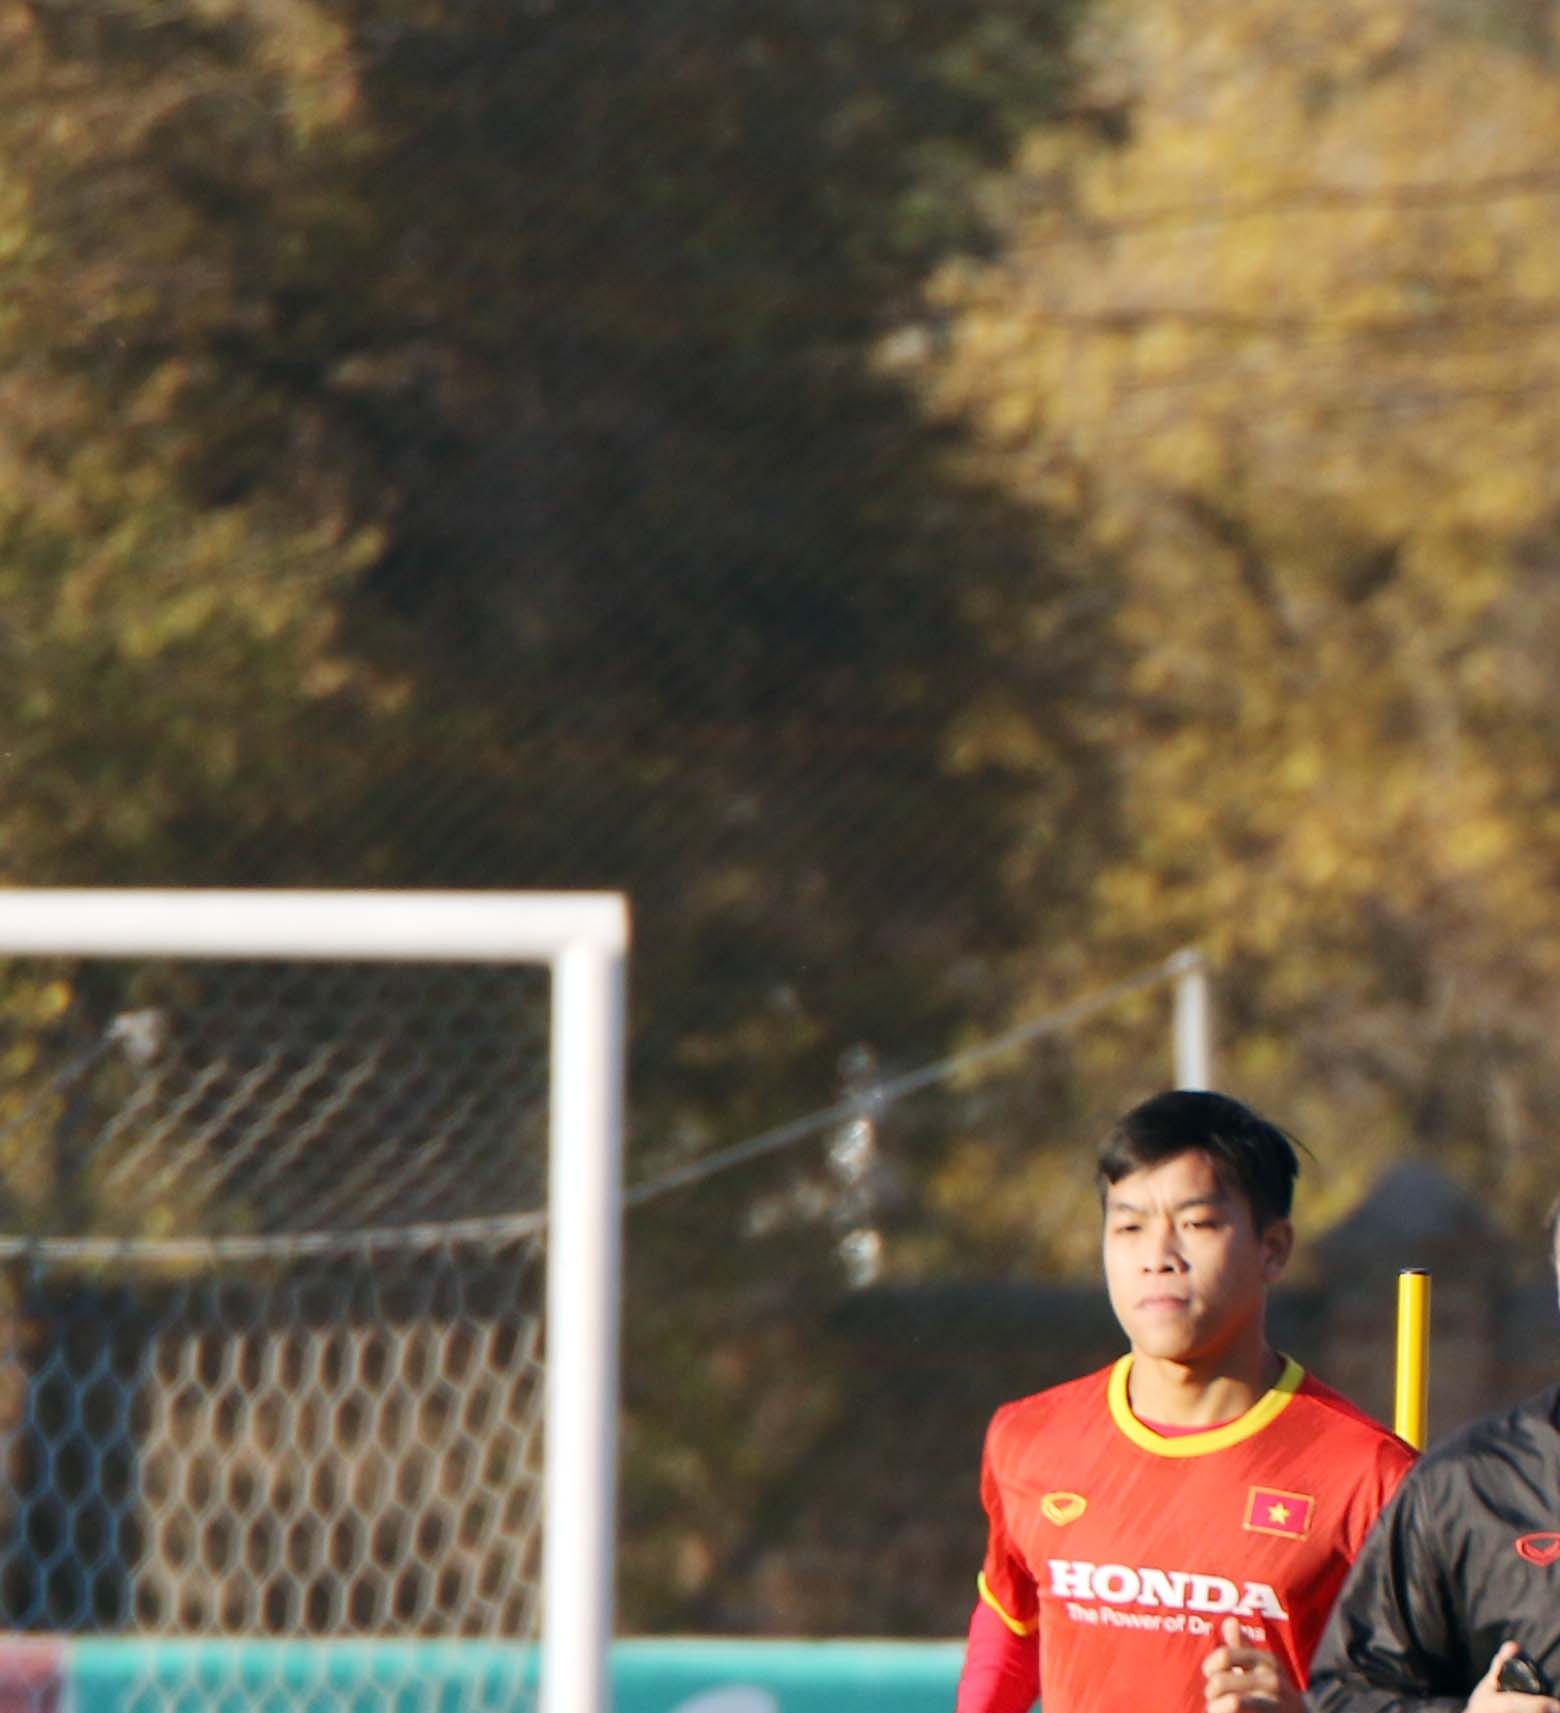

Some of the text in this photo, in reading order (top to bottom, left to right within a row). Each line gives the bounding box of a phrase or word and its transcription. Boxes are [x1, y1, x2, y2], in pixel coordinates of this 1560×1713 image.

[1047, 1559, 1289, 1620] HONDA
[1065, 1602, 1267, 1642] The Power of Drms
